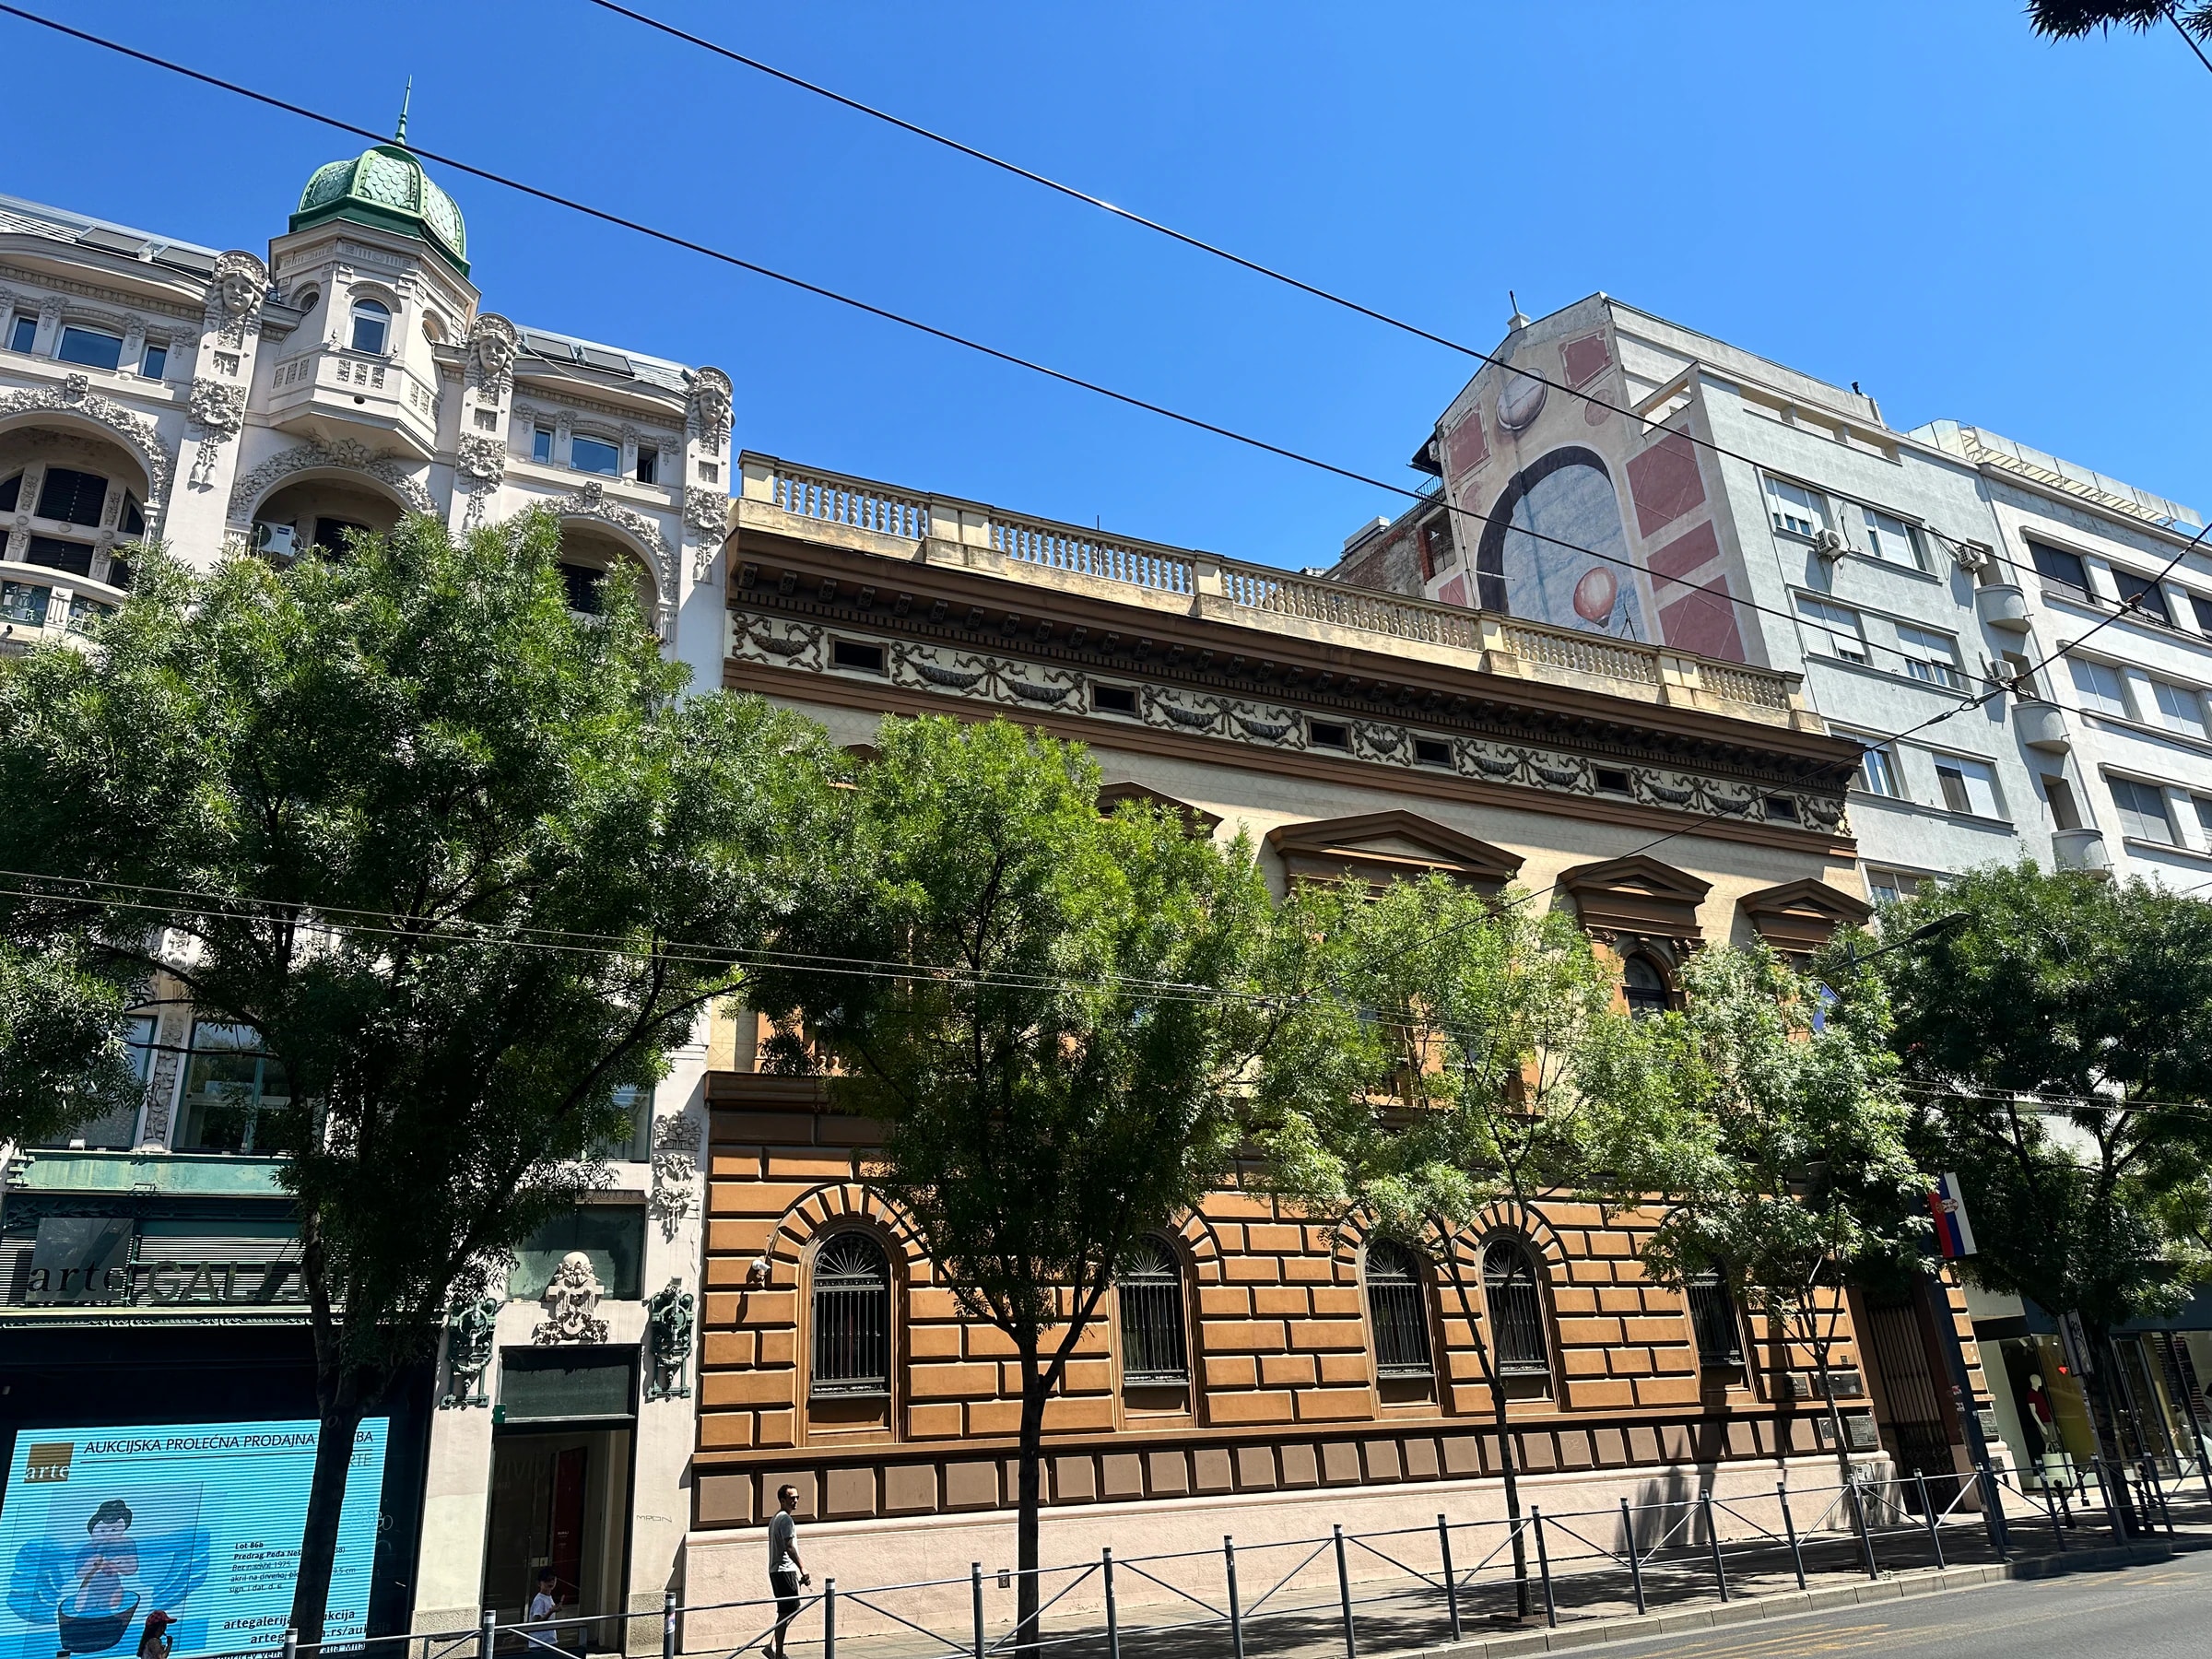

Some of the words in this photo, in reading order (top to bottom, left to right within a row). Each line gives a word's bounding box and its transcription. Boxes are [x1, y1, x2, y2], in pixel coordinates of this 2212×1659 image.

[28, 1261, 125, 1292] arte
[84, 1439, 161, 1454] AUKCIJSKA
[166, 1434, 240, 1451] PROLEĆNA
[243, 1433, 315, 1448] PRODAJNA
[25, 1465, 70, 1480] arte
